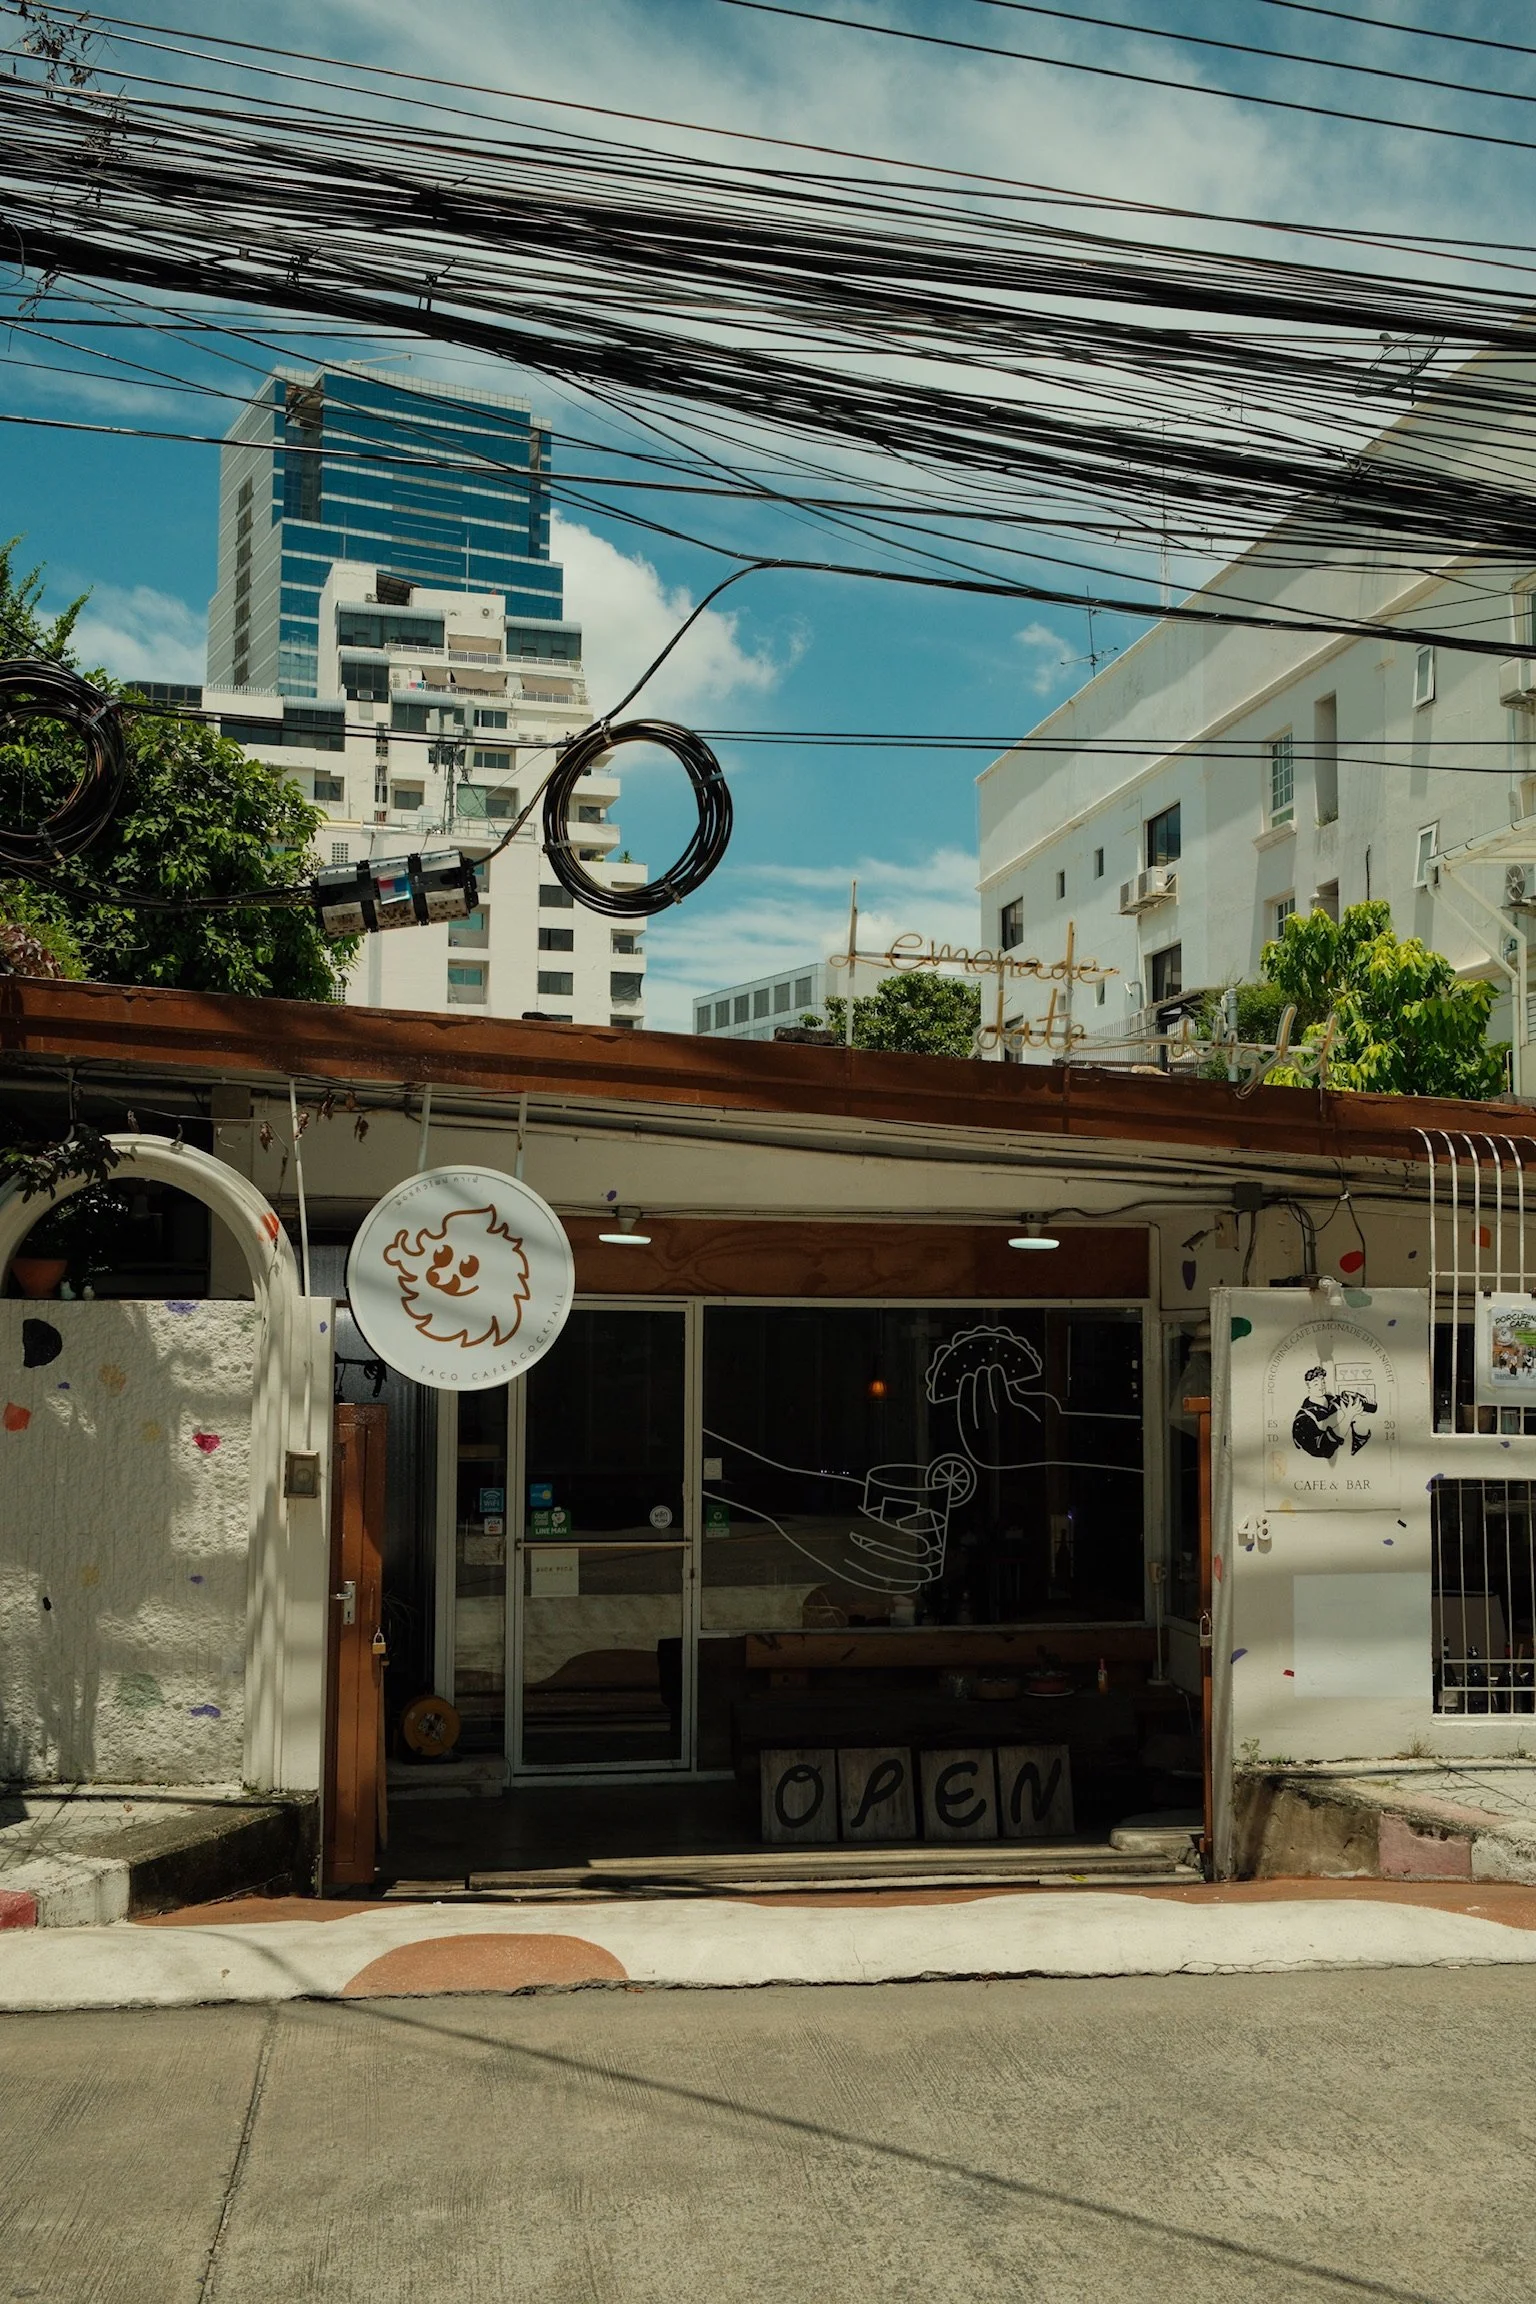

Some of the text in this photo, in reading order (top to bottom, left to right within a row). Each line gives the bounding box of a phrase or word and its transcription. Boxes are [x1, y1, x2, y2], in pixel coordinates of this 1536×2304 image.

[829, 881, 1120, 984] Lemonade
[1509, 1320, 1531, 1328] CAFE
[1267, 1322, 1395, 1394] PORCUPINE CAFE LEMONADE DATE NIGHT
[420, 1364, 458, 1381] TACO
[1267, 1420, 1396, 1429] ES 20
[1267, 1432, 1396, 1443] TD 14
[1293, 1479, 1371, 1491] CAFE & BAR
[534, 1526, 567, 1535] LINE MAN
[1238, 1516, 1272, 1541] 48
[774, 1757, 1062, 1828] OPEN
